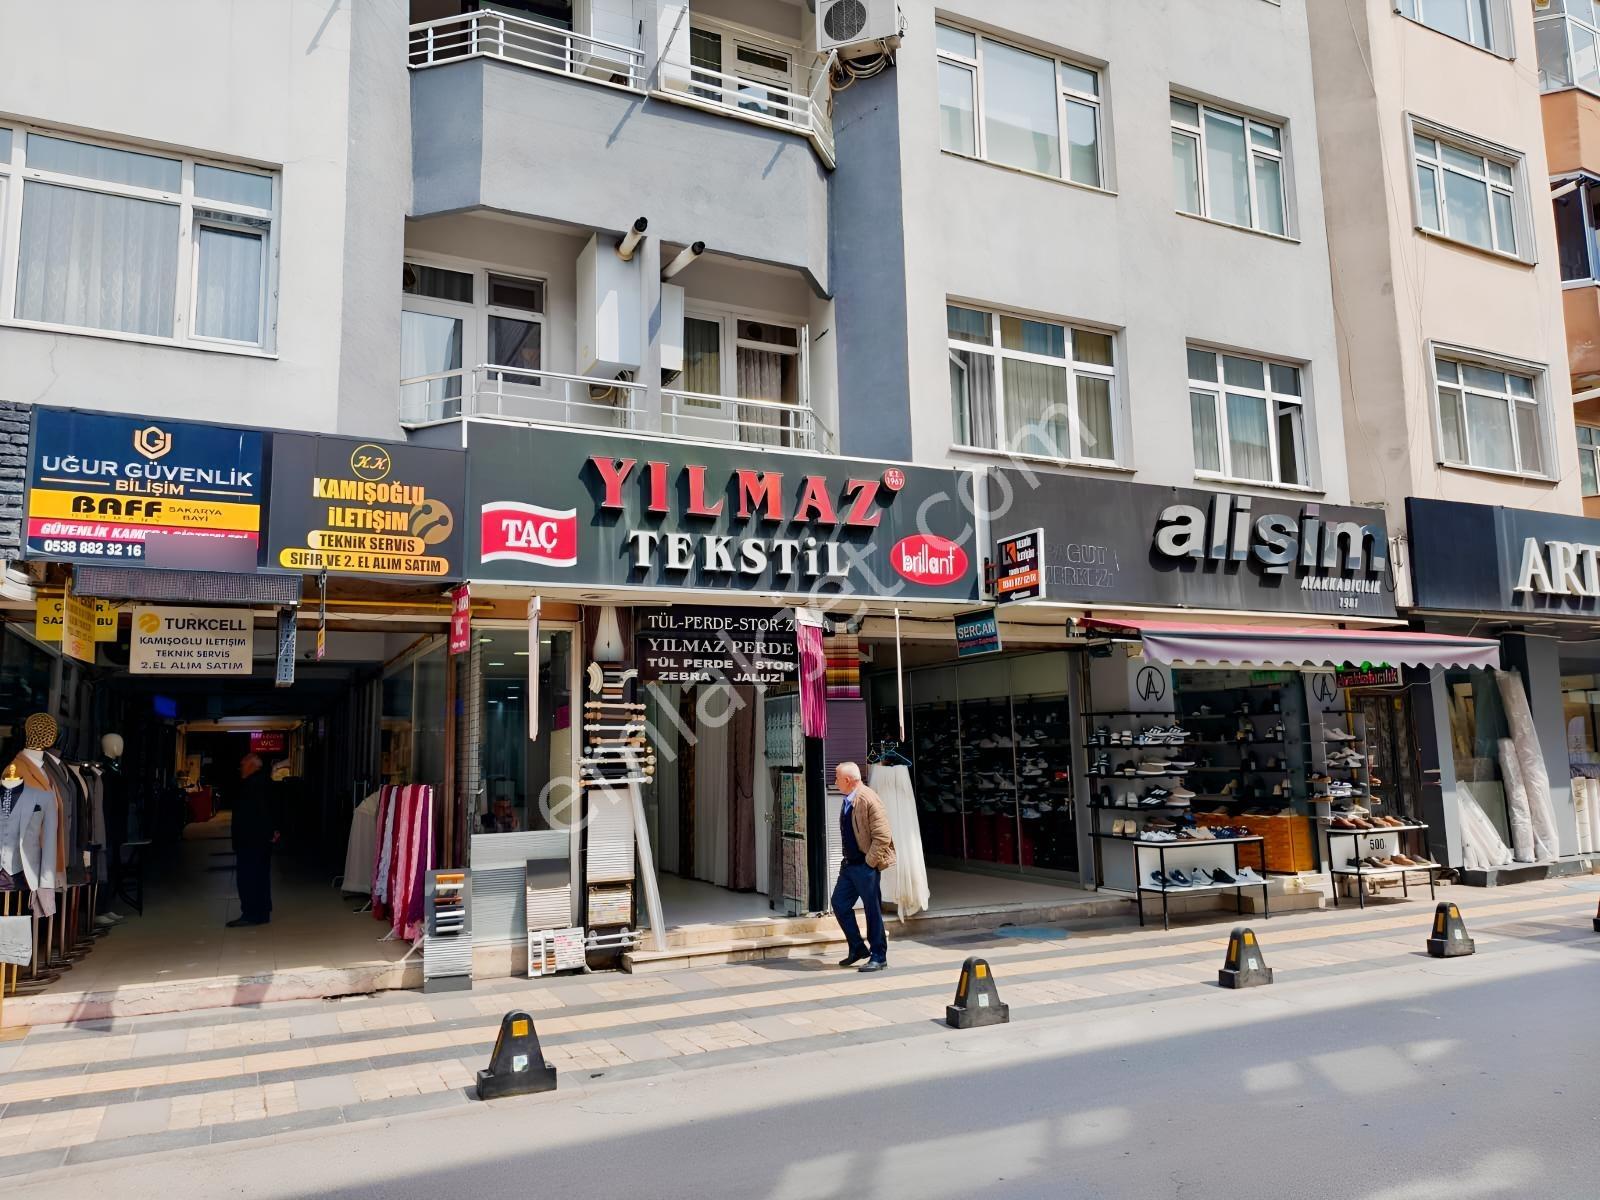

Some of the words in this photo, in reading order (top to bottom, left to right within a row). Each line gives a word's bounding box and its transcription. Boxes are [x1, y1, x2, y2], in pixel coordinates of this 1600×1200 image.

[42, 454, 119, 477] UĞUR
[124, 461, 255, 488] GÜVENLİK
[115, 477, 185, 497] BİLİŞİM
[886, 477, 903, 486] 1967
[312, 477, 425, 506] KAMIŞOĞLU
[588, 455, 884, 528] YILMAZ
[71, 495, 162, 518] BAFF
[168, 506, 223, 518] SAKARYA
[40, 521, 110, 538] GÜVENLİK
[501, 518, 558, 554] TAÇ
[1154, 492, 1386, 576] alişim
[44, 539, 77, 554] 0538
[106, 543, 123, 556] 32
[126, 544, 142, 557] 16
[290, 552, 323, 567] SIFIR
[326, 553, 342, 567] VE
[344, 555, 355, 568] 2.
[357, 556, 370, 569] EL
[372, 557, 402, 571] ALIM
[404, 558, 441, 573] SATIM
[901, 542, 956, 576] brillant
[1512, 536, 1600, 598] ART
[1299, 575, 1382, 595] AYAKKABICILIK
[164, 617, 247, 631] TURKCELL
[957, 620, 996, 639] SERCAN
[647, 638, 726, 654] YILMAZ
[732, 641, 794, 656] PERDE
[170, 661, 202, 670] ALIM
[206, 661, 243, 670] SATIM
[647, 656, 679, 668] TÜL
[683, 658, 734, 669] PERDE
[755, 660, 795, 672] STOR
[658, 671, 711, 682] ZEBRA
[733, 671, 785, 683] JALUZİ
[1369, 838, 1385, 850] 500
